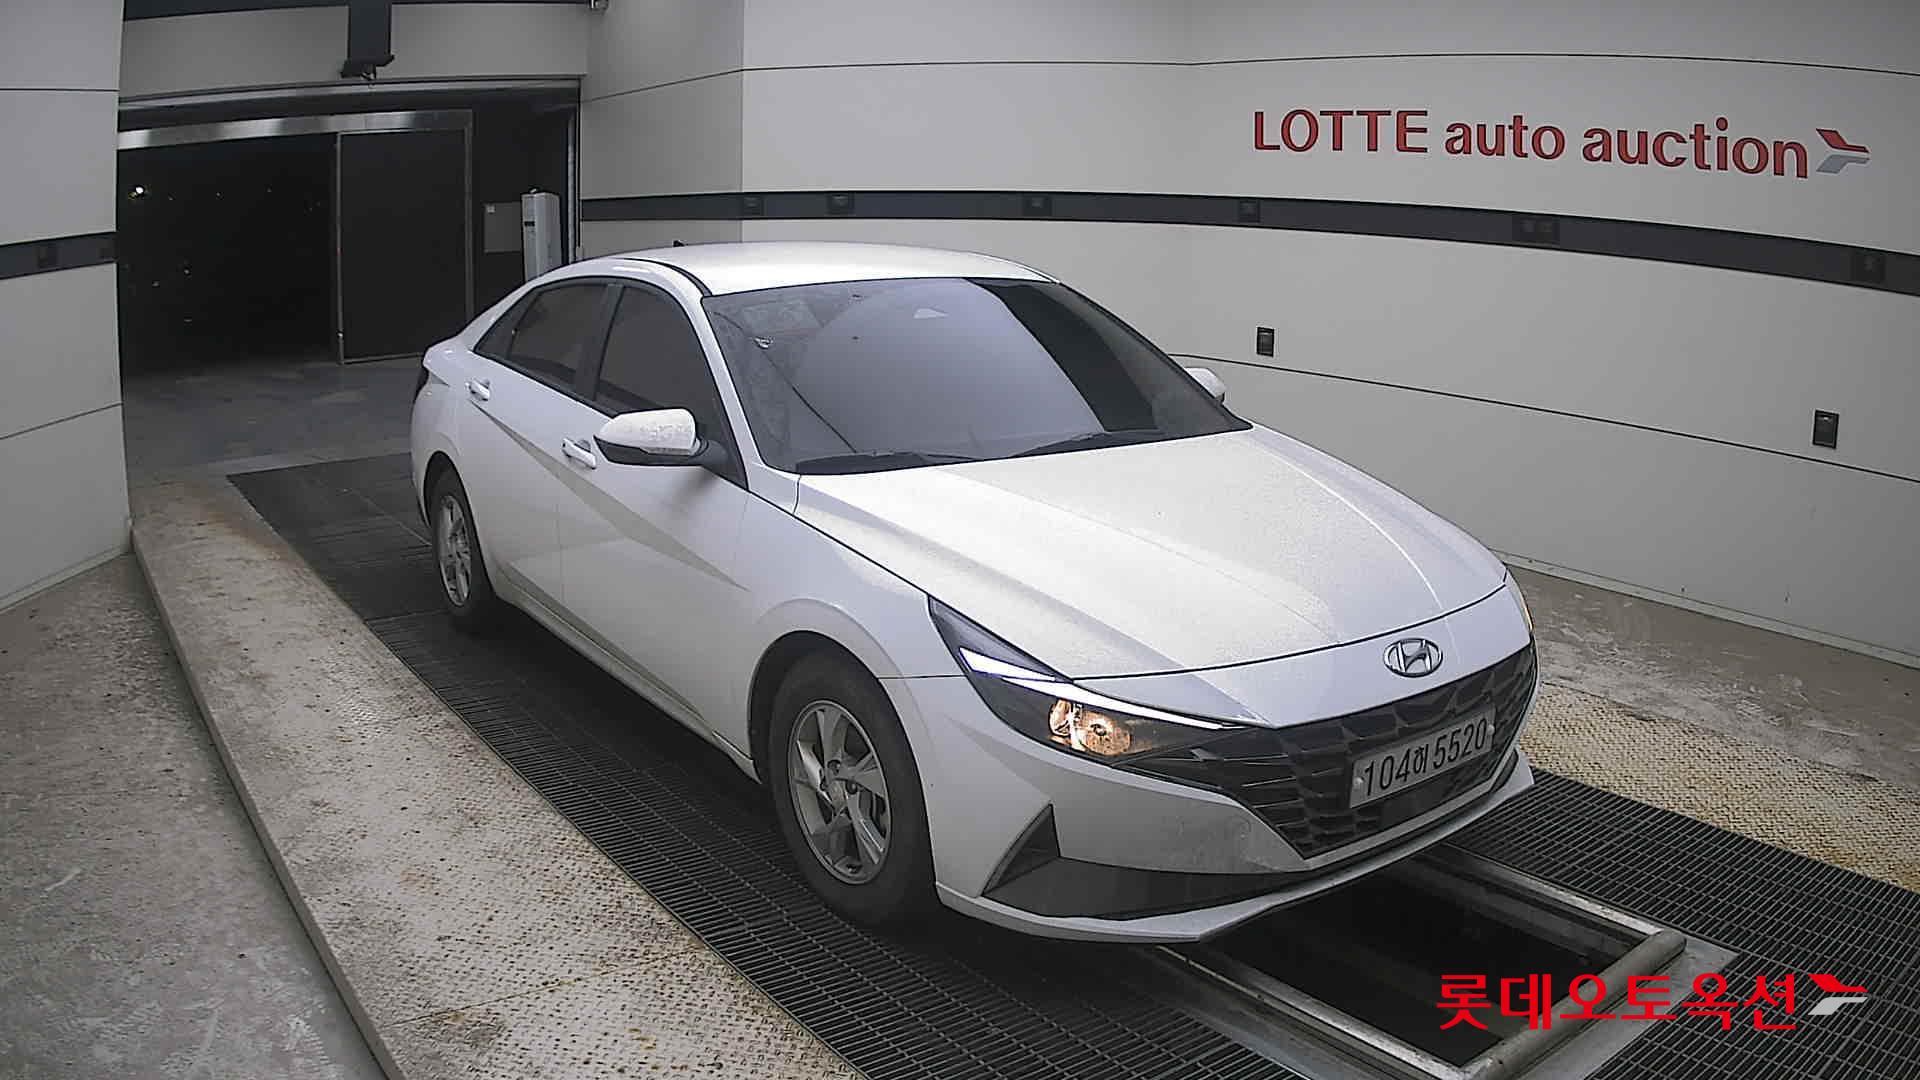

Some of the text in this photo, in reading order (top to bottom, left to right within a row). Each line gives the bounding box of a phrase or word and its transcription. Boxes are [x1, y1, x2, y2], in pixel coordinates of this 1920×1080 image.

[1254, 110, 1808, 179] LOTTE auto auction
[1433, 718, 1487, 768] 5520
